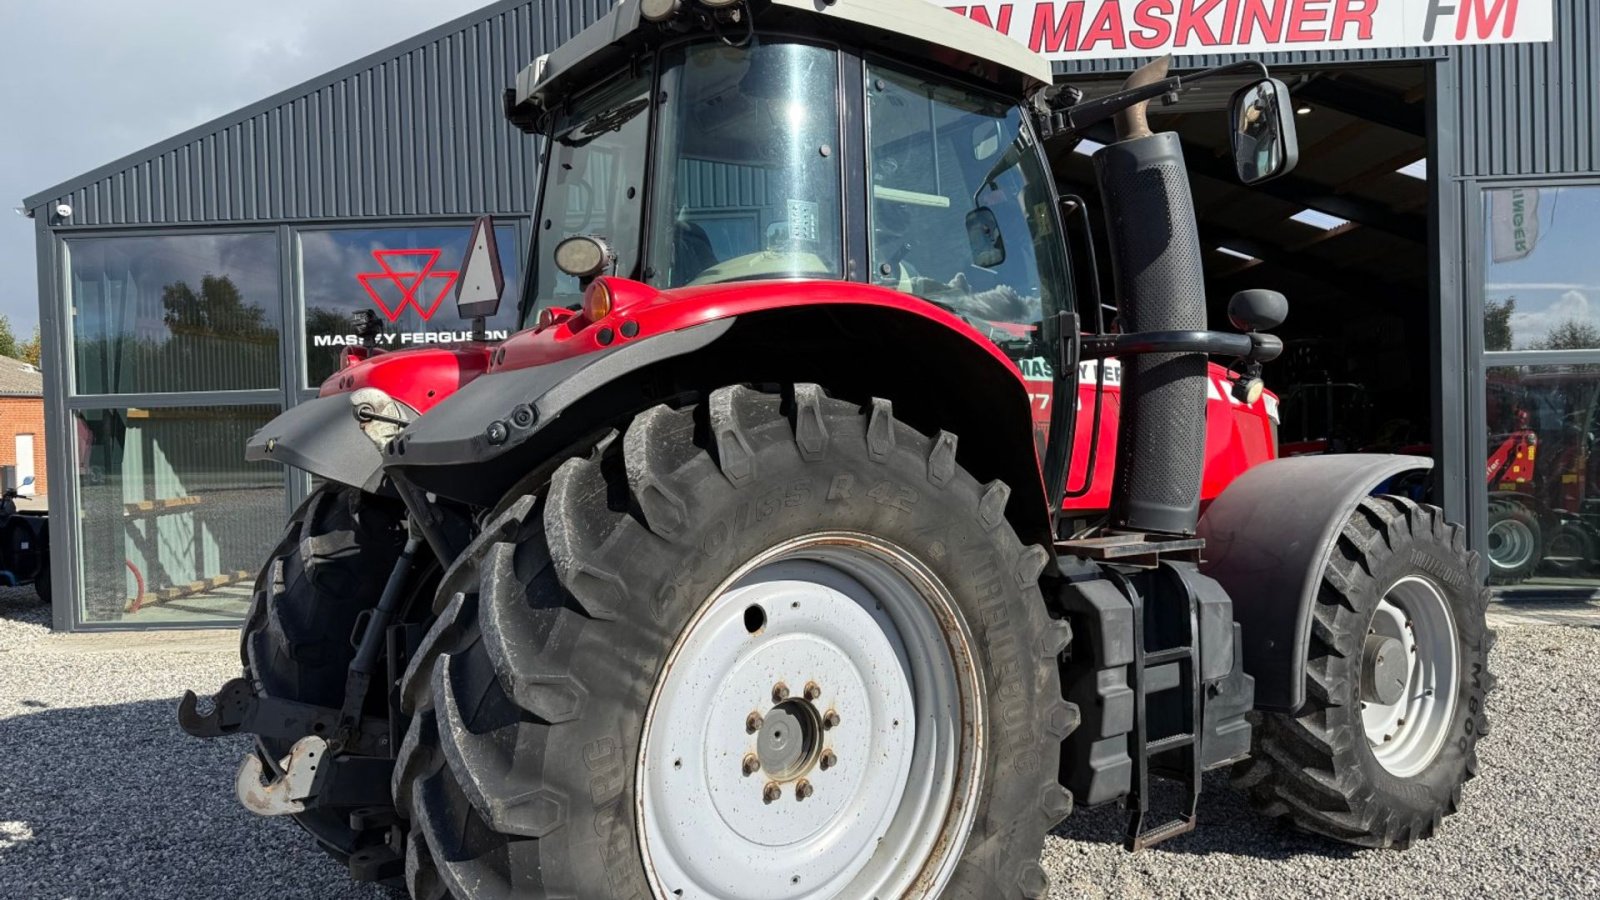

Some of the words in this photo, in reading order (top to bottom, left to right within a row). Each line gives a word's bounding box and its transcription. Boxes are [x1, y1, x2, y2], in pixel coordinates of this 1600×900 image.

[1028, 0, 1378, 53] MASKINER
[1422, 0, 1519, 42] FM
[825, 472, 858, 502] R
[866, 479, 921, 515] 42
